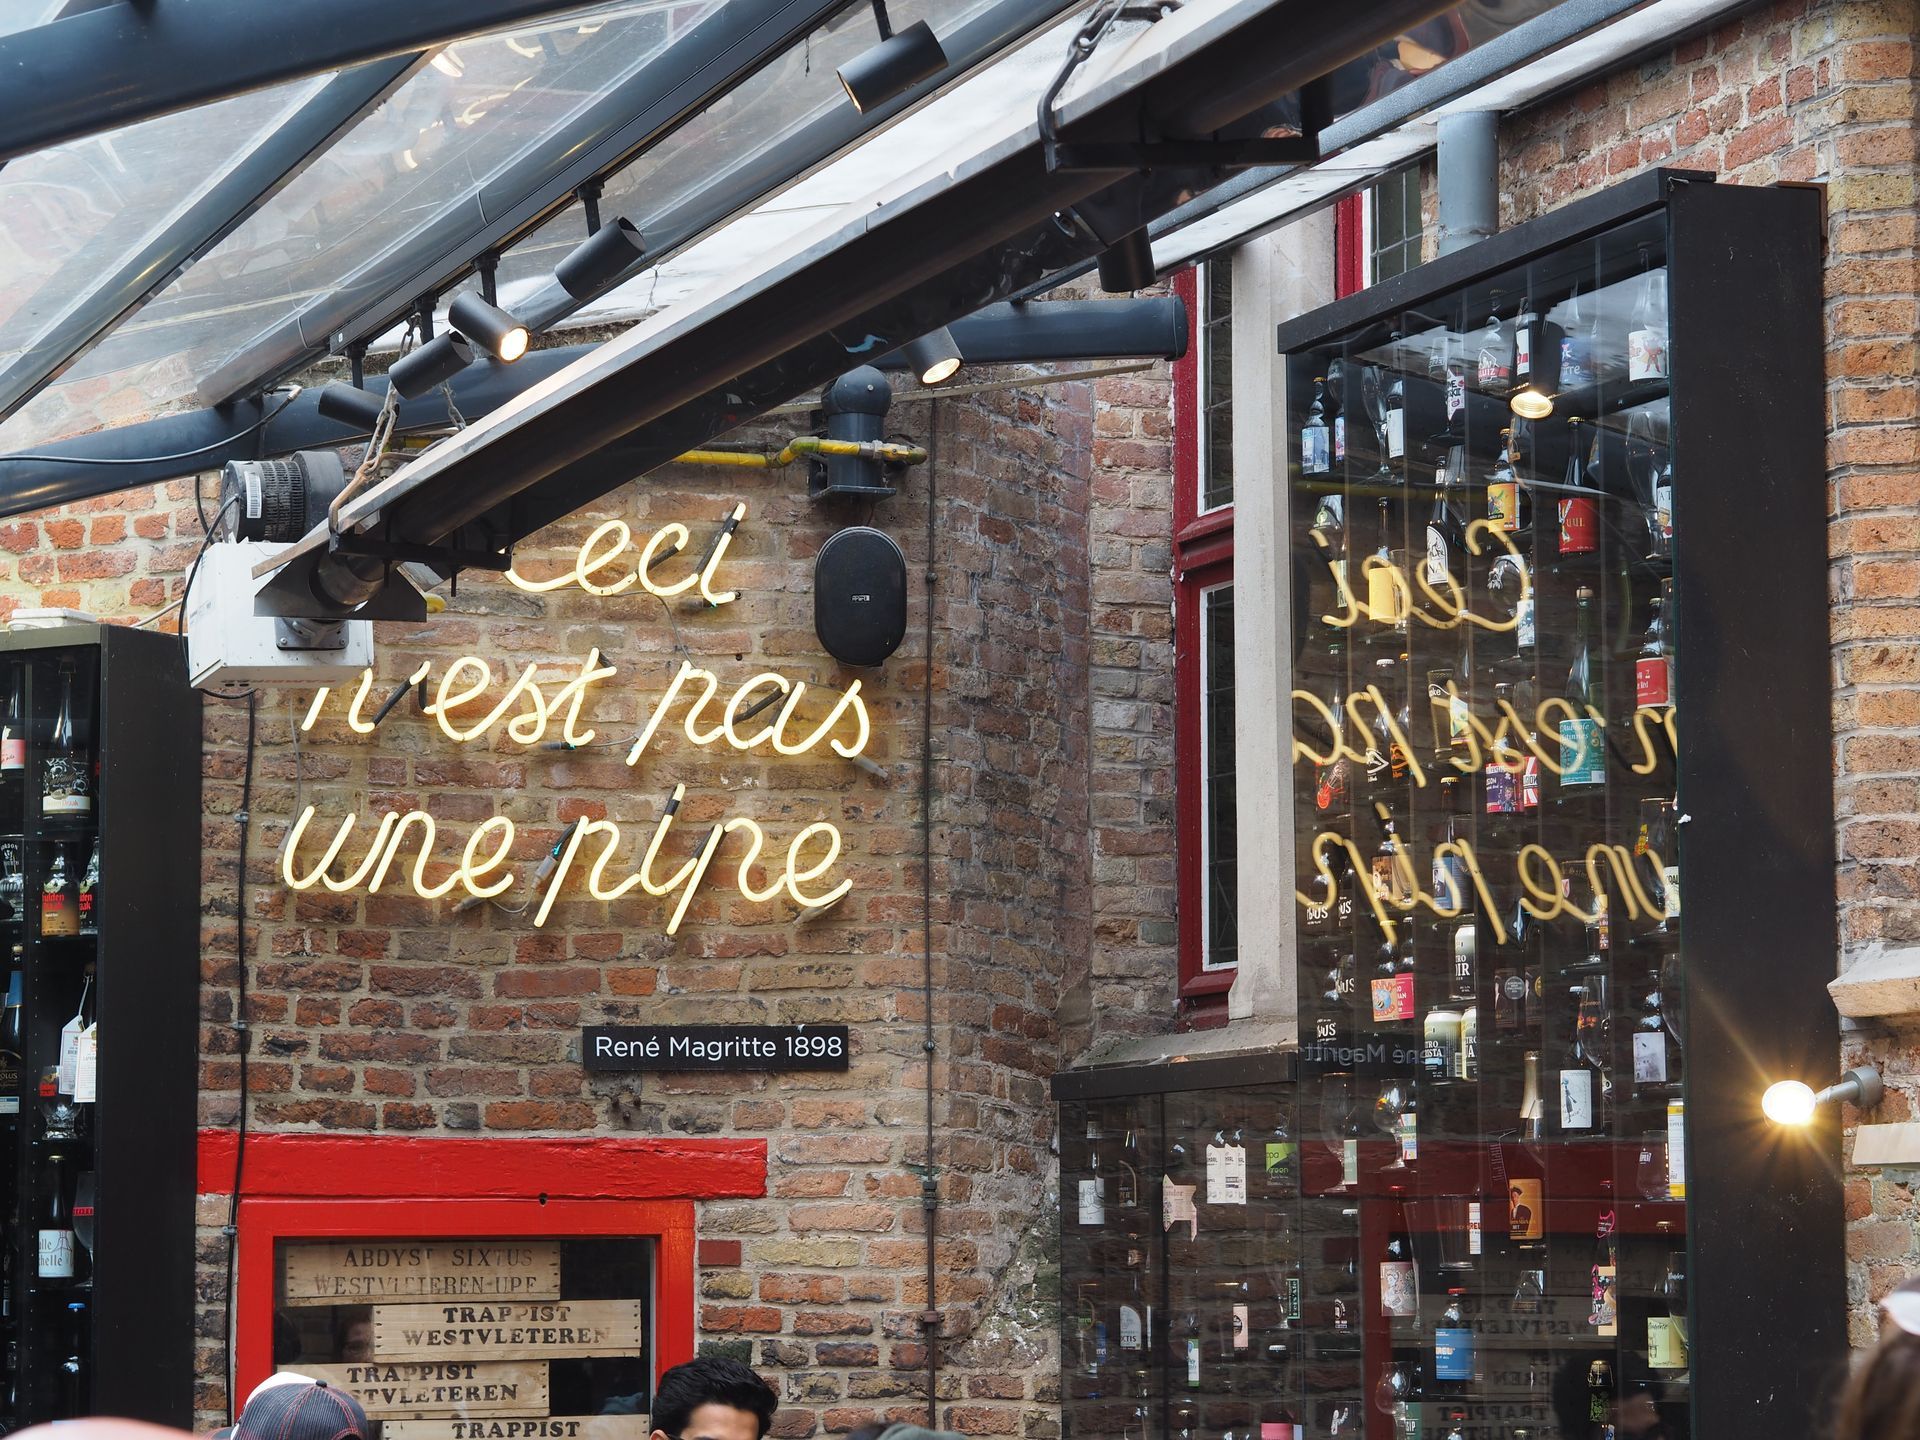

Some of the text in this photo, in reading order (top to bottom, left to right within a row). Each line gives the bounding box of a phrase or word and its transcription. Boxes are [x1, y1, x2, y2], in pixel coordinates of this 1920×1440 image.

[498, 502, 746, 603] eci
[625, 660, 871, 766] pas
[282, 783, 853, 935] une pipe
[595, 1036, 843, 1061] René Magritte 1898
[442, 1306, 571, 1323] TRAPPIST
[401, 1327, 611, 1346] WESTVLETEREN
[346, 1364, 477, 1384] TRAPPIST
[351, 1384, 518, 1405] STVLETEREN
[451, 1421, 580, 1440] TRAPPIST
